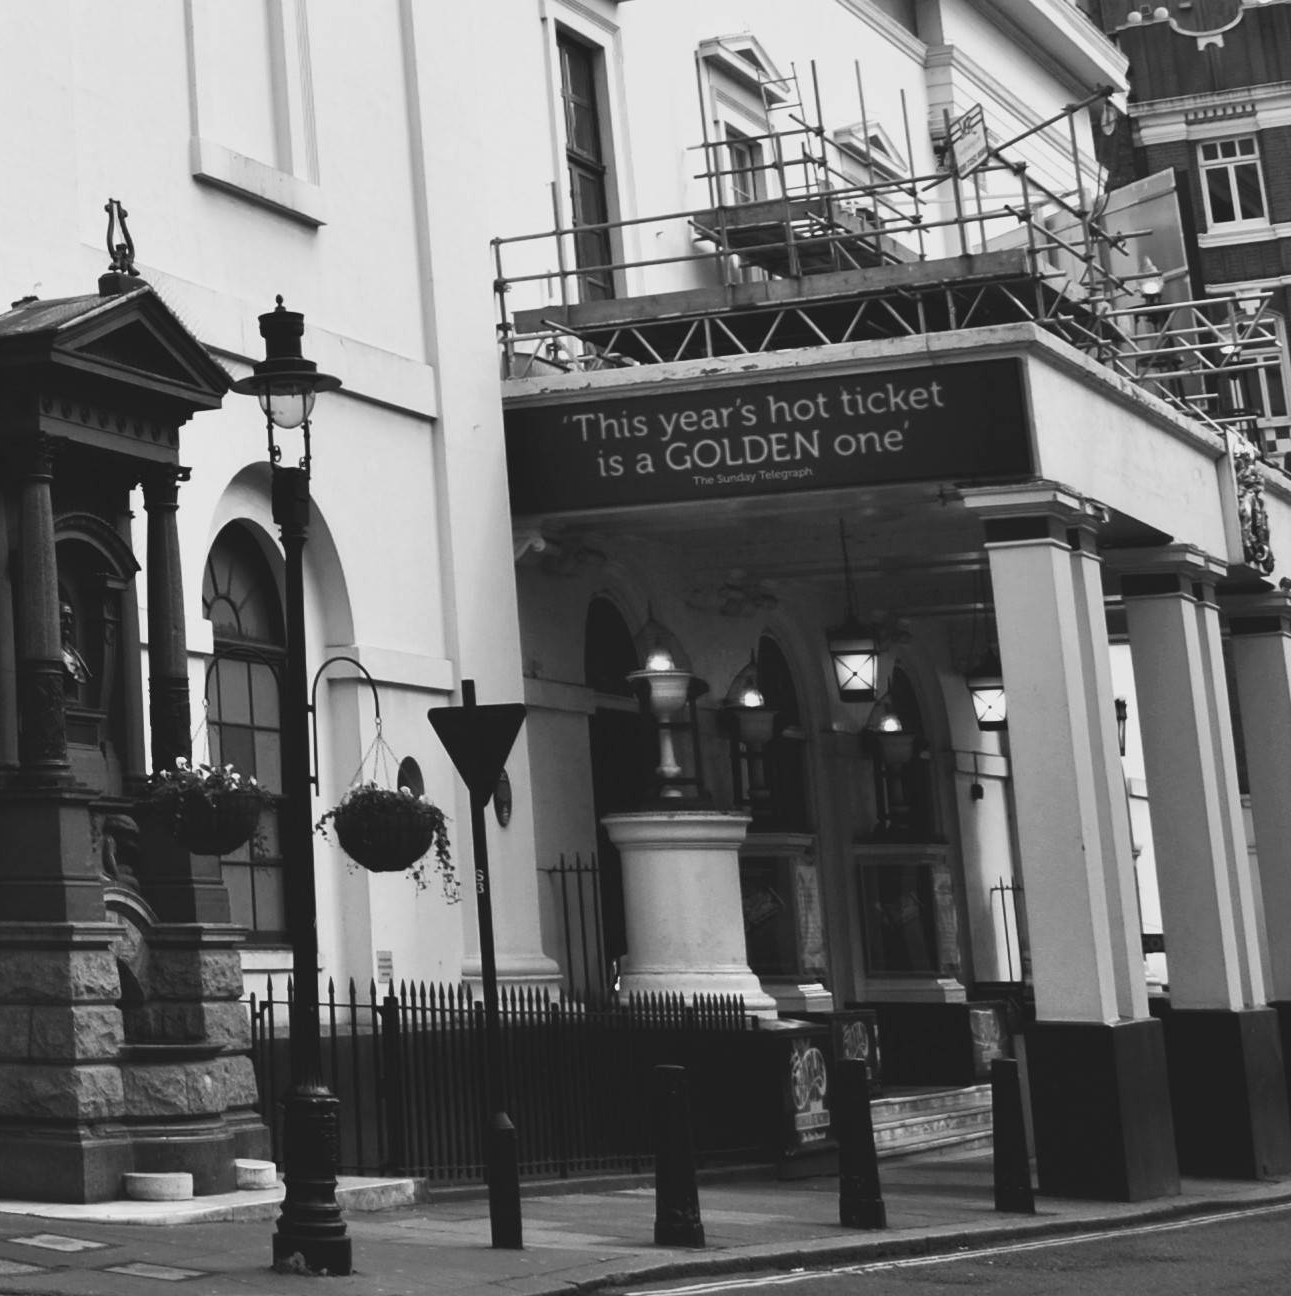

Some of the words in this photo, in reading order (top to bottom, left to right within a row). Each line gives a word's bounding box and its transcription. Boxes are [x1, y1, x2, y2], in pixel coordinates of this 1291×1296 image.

[659, 398, 758, 441] year's
[767, 392, 830, 424] hot
[839, 381, 945, 416] ticket
[597, 450, 625, 477] is
[635, 453, 655, 474] a
[666, 430, 820, 470] GOLDEN
[692, 475, 715, 486] The
[716, 471, 757, 484] Sunday
[760, 467, 814, 482] Telegraph
